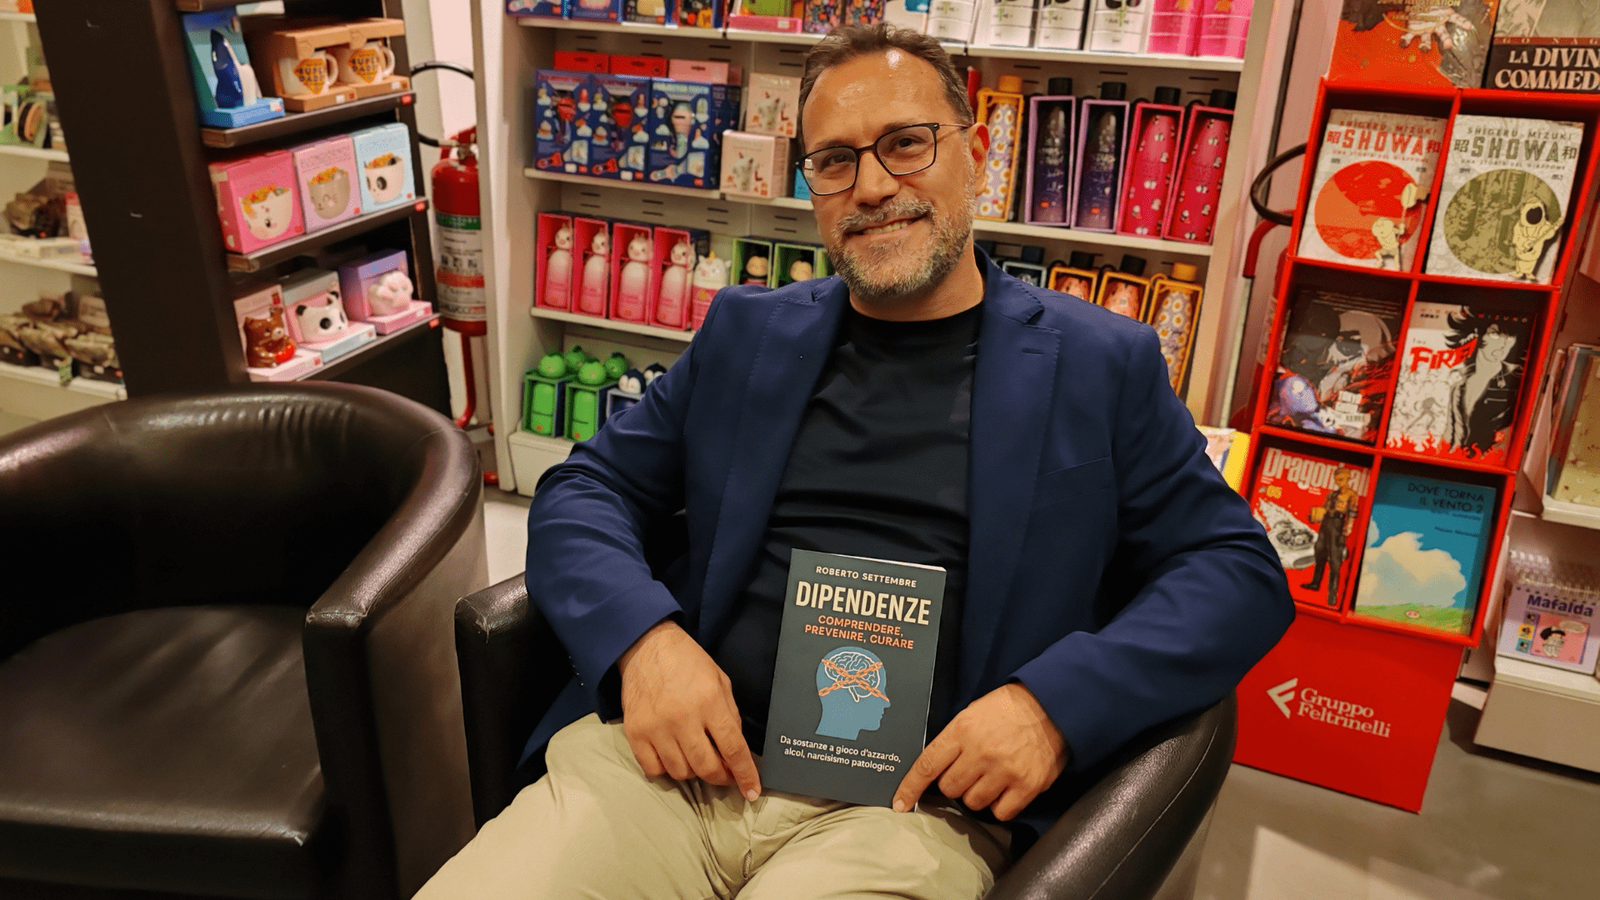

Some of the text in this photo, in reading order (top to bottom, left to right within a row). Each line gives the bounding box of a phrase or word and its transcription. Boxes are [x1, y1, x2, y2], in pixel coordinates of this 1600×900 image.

[1508, 50, 1529, 63] LA
[1495, 69, 1600, 90] COMMED
[1340, 120, 1436, 135] SHIGERU MIZUKI
[1467, 127, 1572, 140] SHIGERU MIZUKI
[1342, 129, 1423, 156] SHOWA
[1454, 136, 1577, 162] 昭 SHOWA 和
[1262, 446, 1370, 498] Dragonall
[1408, 482, 1484, 502] DOVE TORNA
[1433, 499, 1472, 512] VENTO
[1476, 504, 1483, 514] 2
[816, 566, 917, 588] ROBERTO SETTEMBRE
[795, 580, 932, 625] DIPENDENZE
[1527, 594, 1593, 617] Mafalda
[805, 624, 915, 649] PREVENIRE, CURARE
[818, 615, 904, 637] COMPRENDERE,
[1300, 688, 1374, 718] Gruppo
[1297, 701, 1391, 738] Feltrinelli
[780, 735, 791, 744] Da
[792, 738, 828, 750] sostanze
[836, 744, 858, 756] gioco
[860, 748, 901, 763] d'azzardo,
[784, 748, 895, 773] alcol, narcisismo patologico
